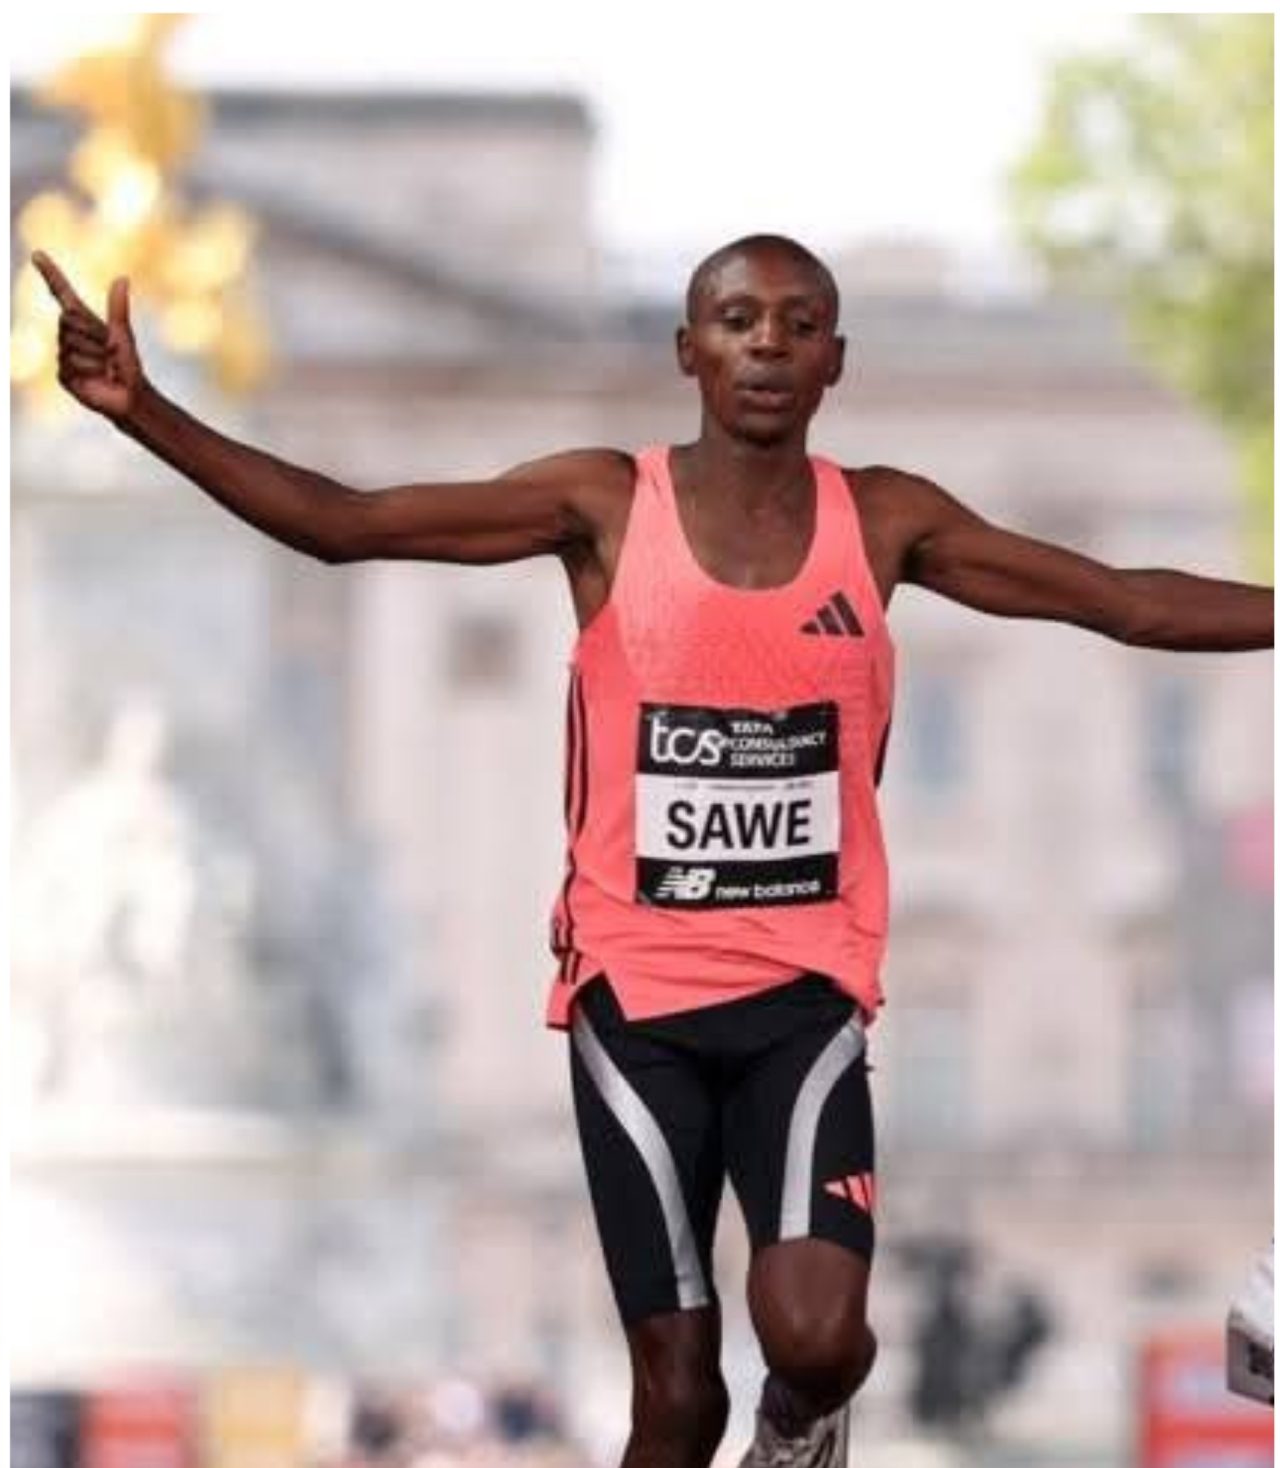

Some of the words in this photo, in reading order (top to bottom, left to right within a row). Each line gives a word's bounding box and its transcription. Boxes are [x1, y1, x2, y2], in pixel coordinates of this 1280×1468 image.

[650, 714, 721, 765] tcs
[731, 722, 774, 735] TATA
[666, 800, 812, 850] SAWE
